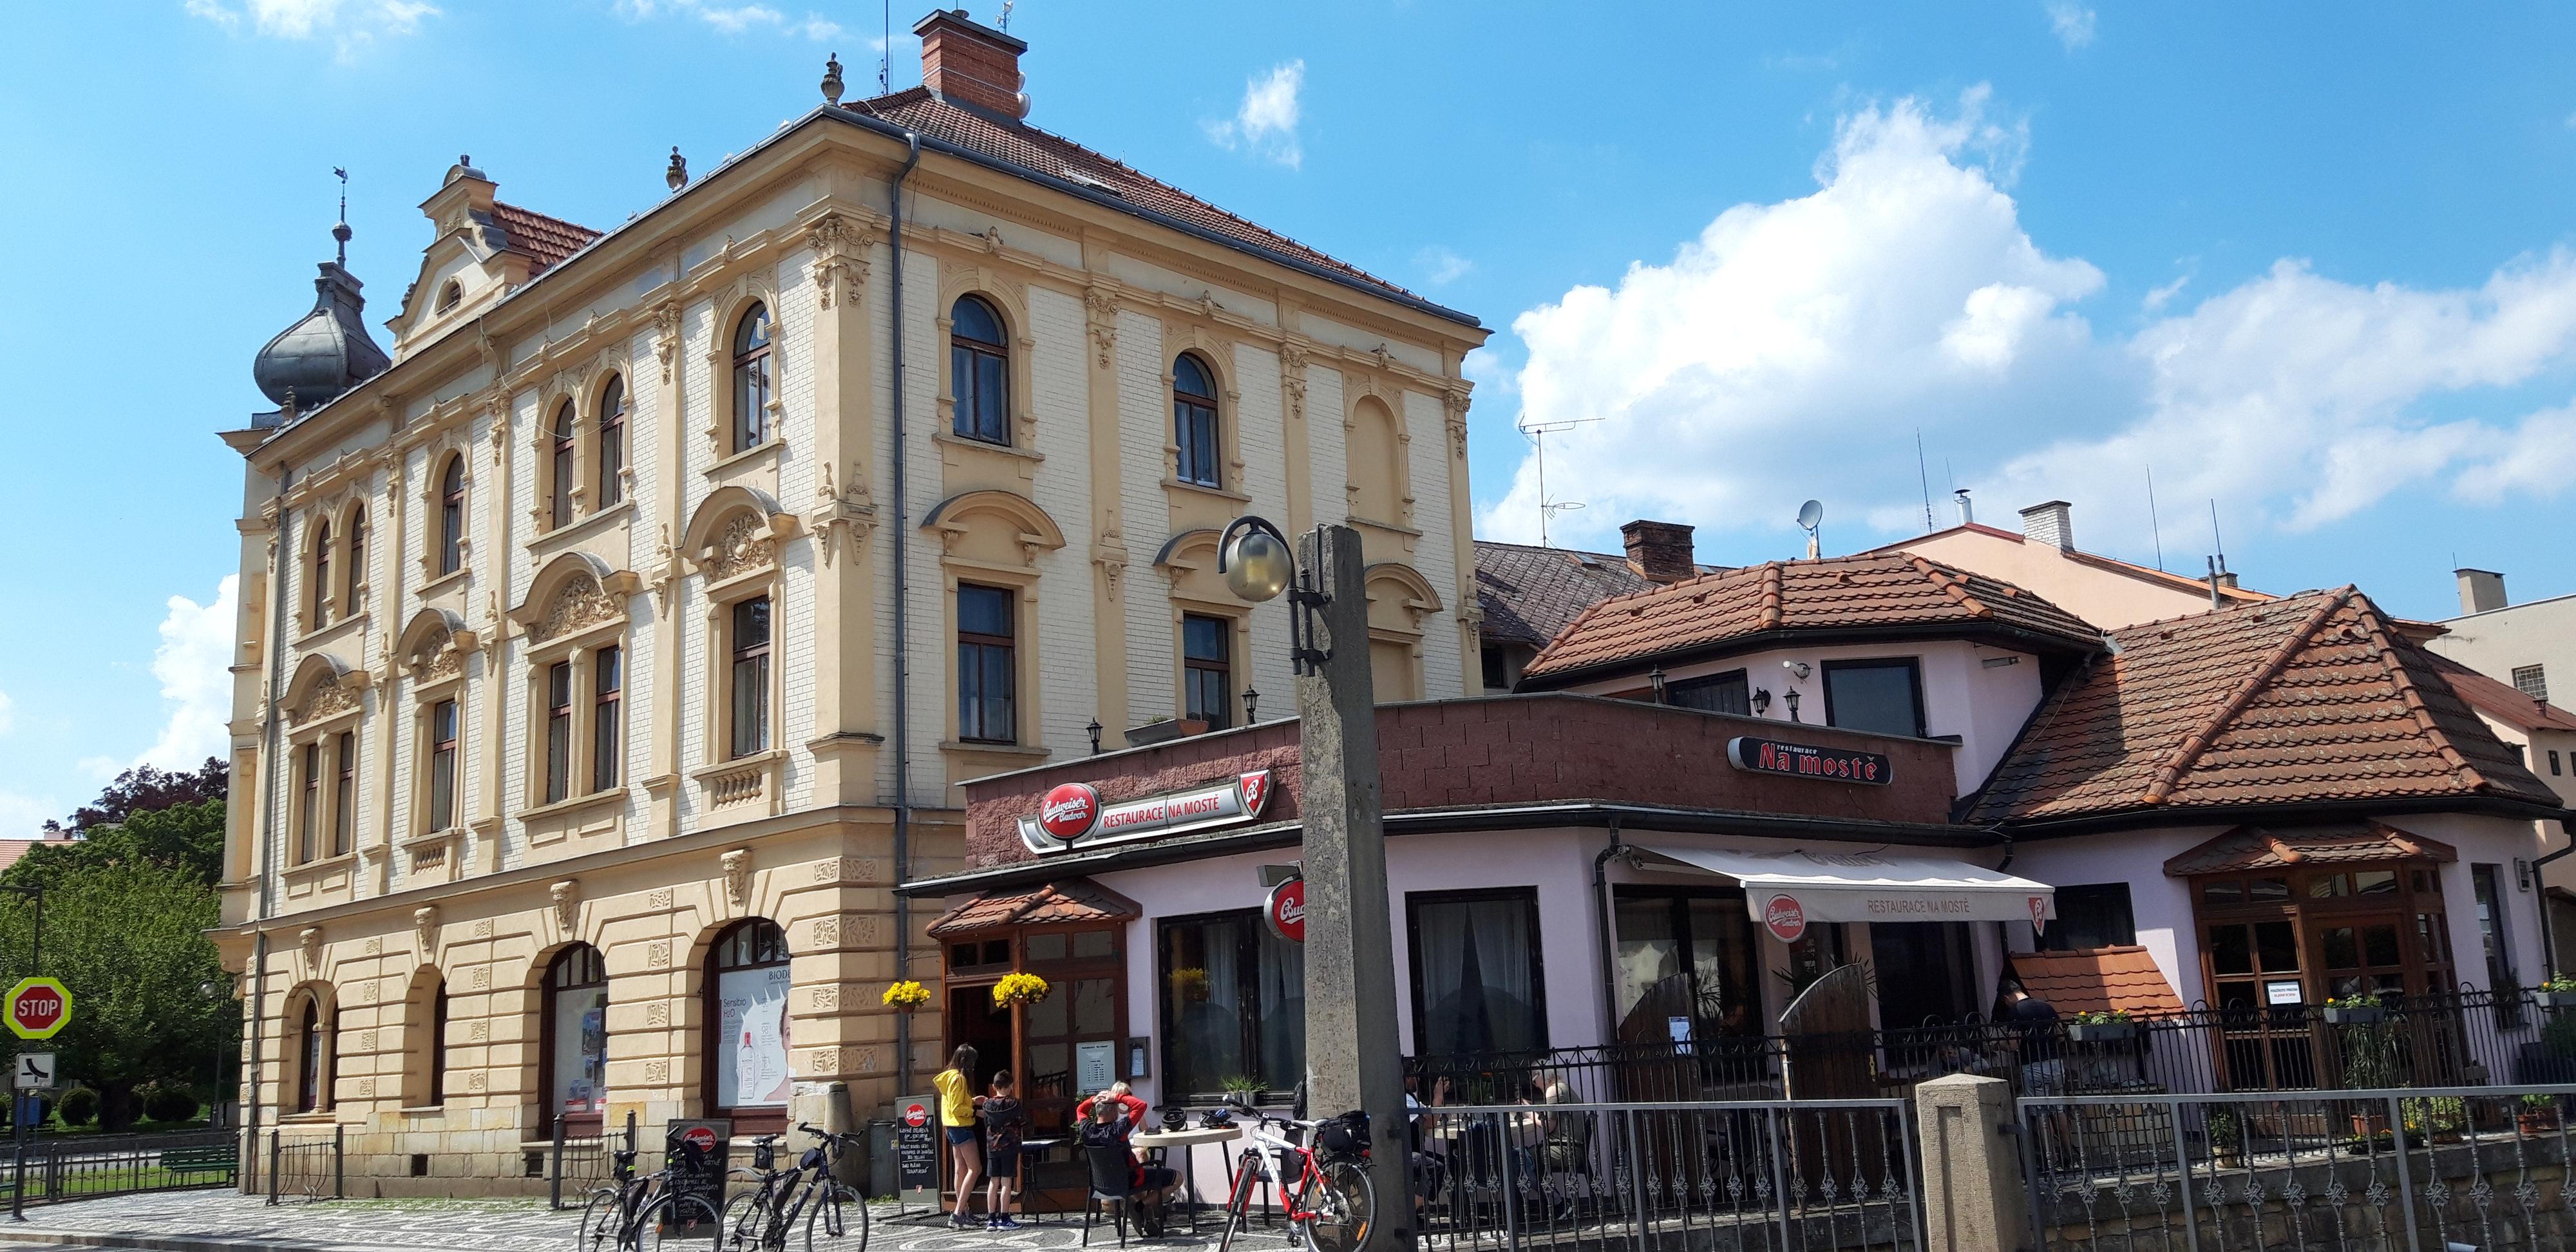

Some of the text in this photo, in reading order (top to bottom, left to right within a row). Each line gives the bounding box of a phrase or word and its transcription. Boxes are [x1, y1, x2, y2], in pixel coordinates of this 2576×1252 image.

[1777, 744, 1818, 755] restaurace
[1759, 742, 1878, 781] Na mostě
[1043, 797, 1090, 822] Budweiser
[1059, 810, 1088, 823] Budvar
[1103, 793, 1220, 828] RESTAURACE NA MOSTĚ
[1868, 898, 1970, 913] RESTAURACE NA MOSTĚ
[18, 1000, 58, 1017] STOP
